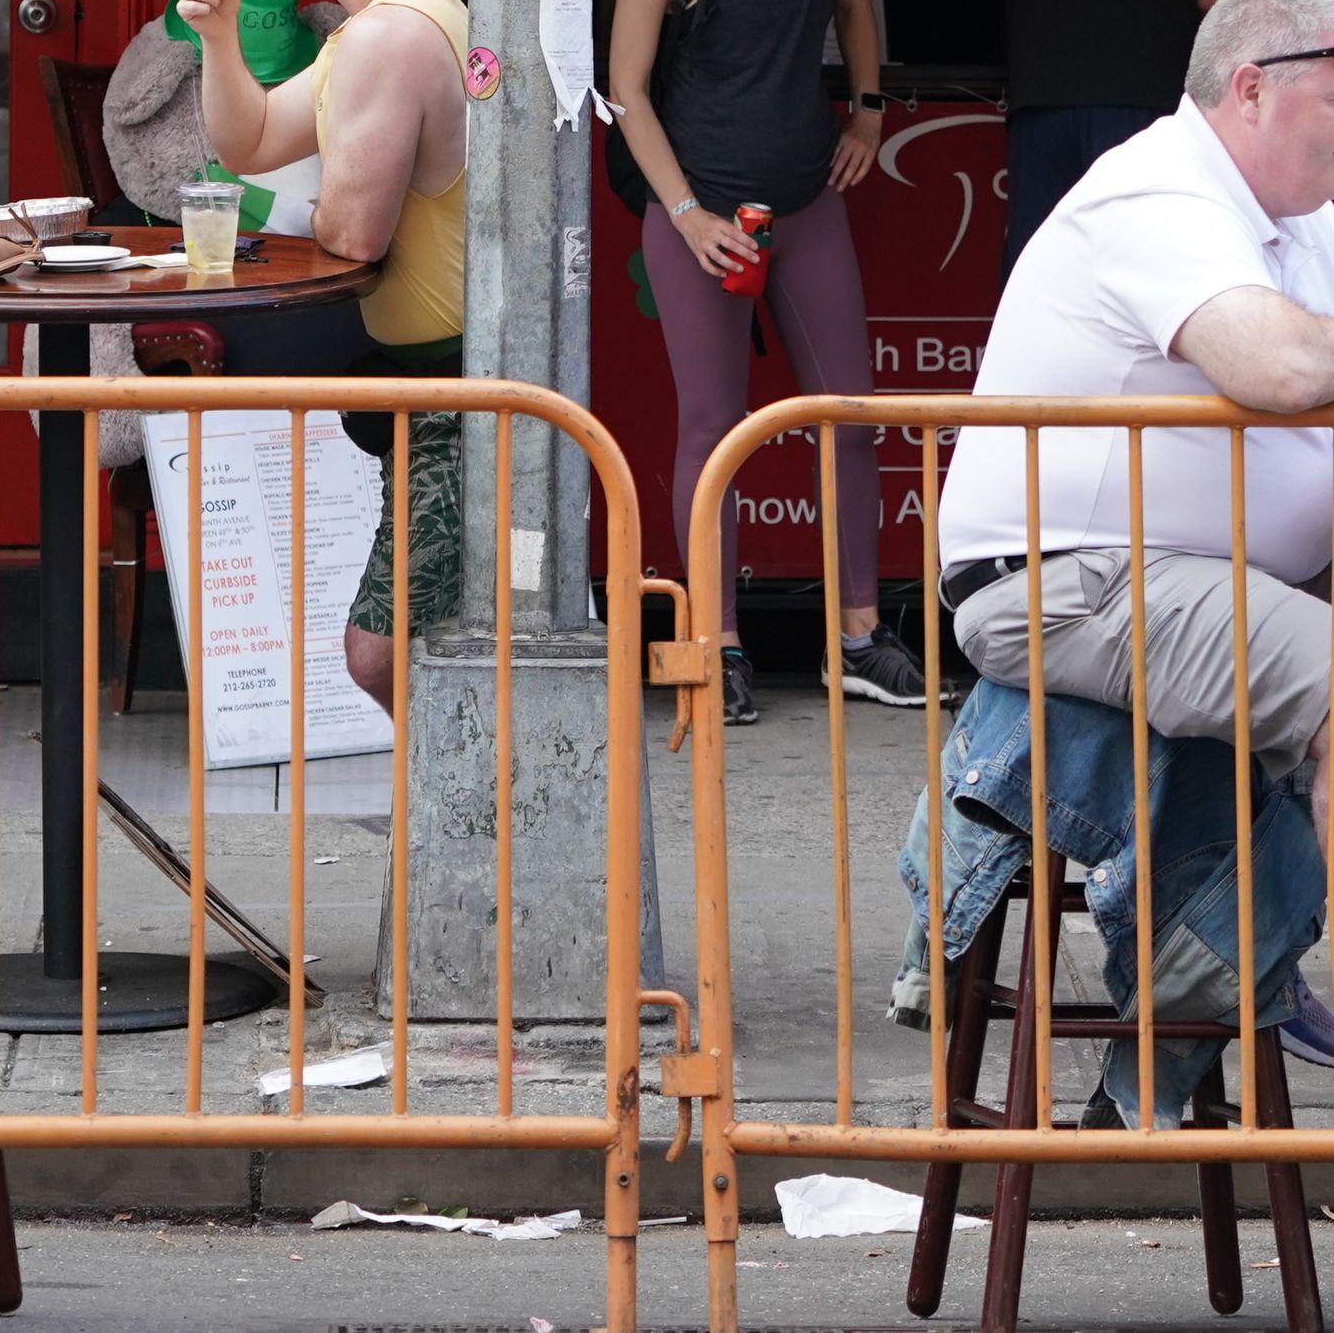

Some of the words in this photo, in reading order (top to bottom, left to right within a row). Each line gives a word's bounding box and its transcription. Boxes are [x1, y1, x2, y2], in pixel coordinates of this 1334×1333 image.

[230, 556, 254, 570] OUT
[204, 574, 257, 591] CURBSIDE
[212, 594, 239, 608] PICK
[240, 593, 255, 606] UP
[210, 629, 237, 642] OPEN
[241, 626, 269, 638] DAILY
[227, 667, 267, 679] TELEPHONE
[223, 678, 276, 692] 212-265-2720
